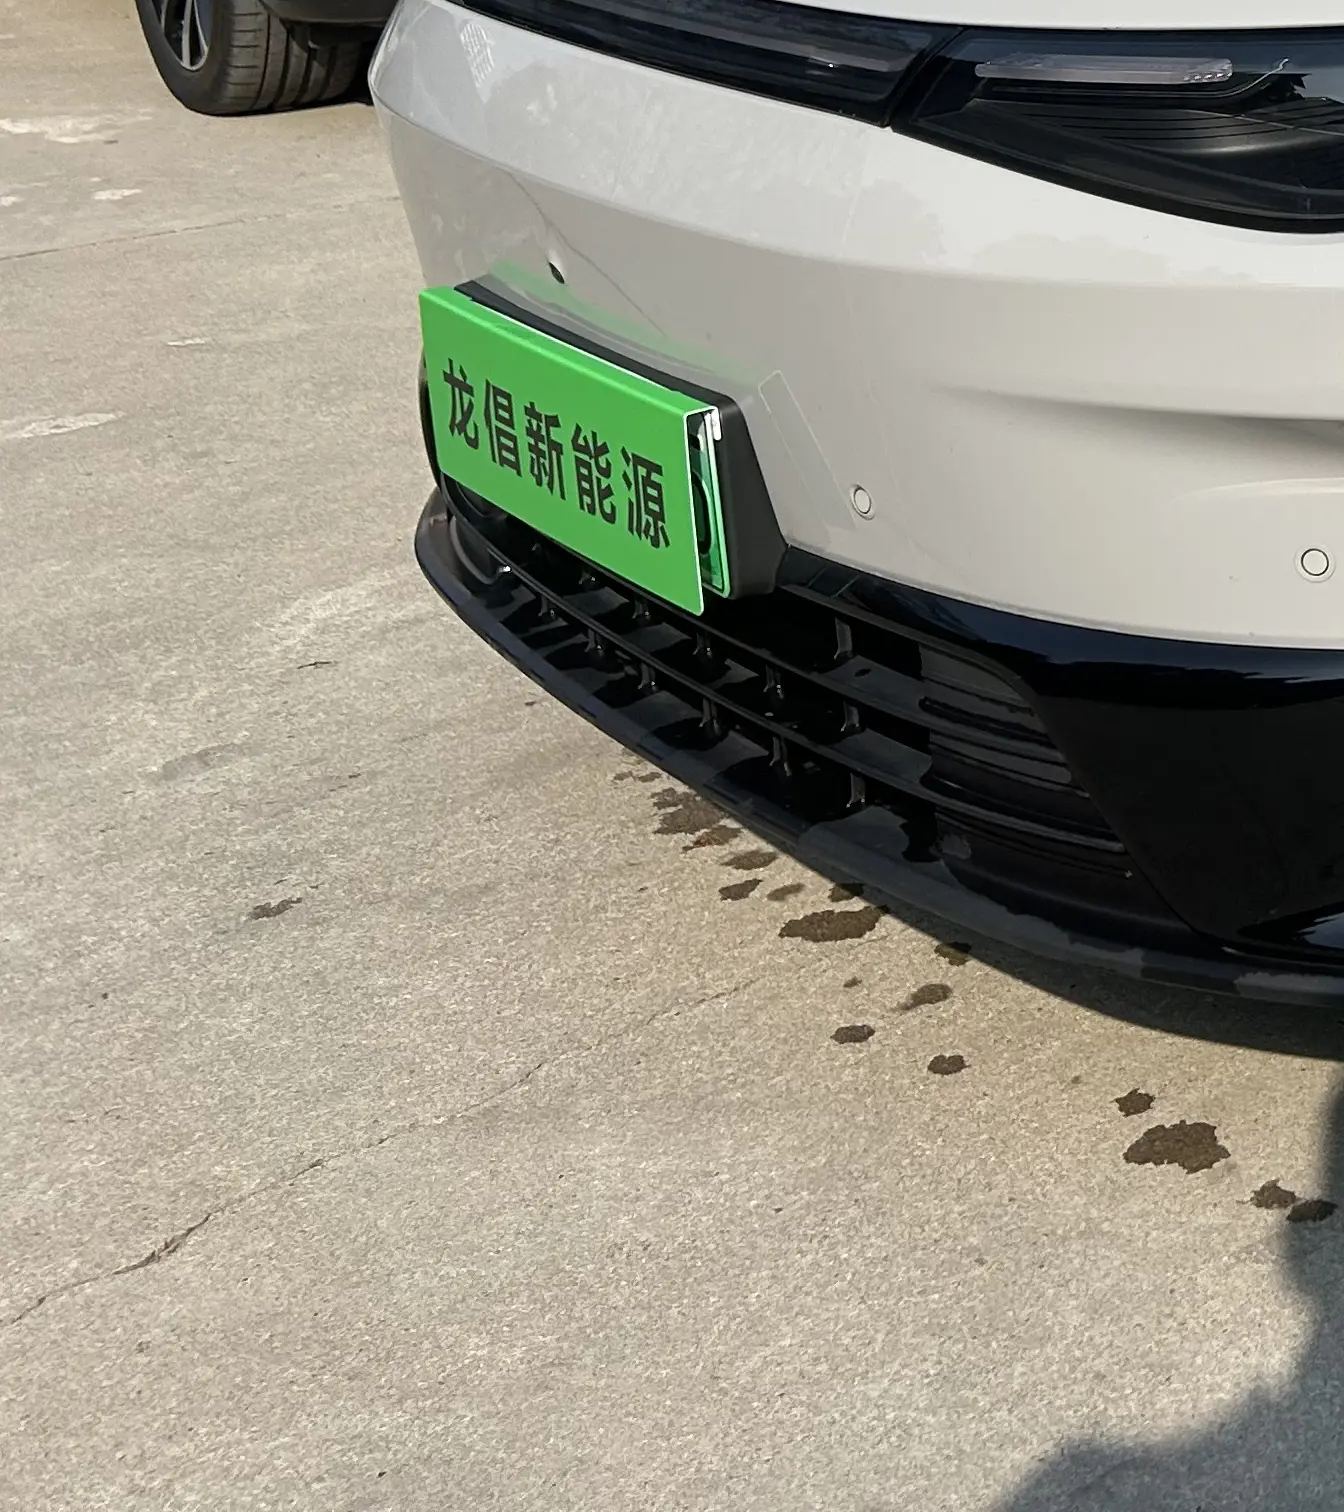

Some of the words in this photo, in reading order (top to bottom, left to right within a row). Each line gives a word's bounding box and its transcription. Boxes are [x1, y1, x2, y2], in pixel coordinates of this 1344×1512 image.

[442, 357, 671, 549] 龙倡新能源
